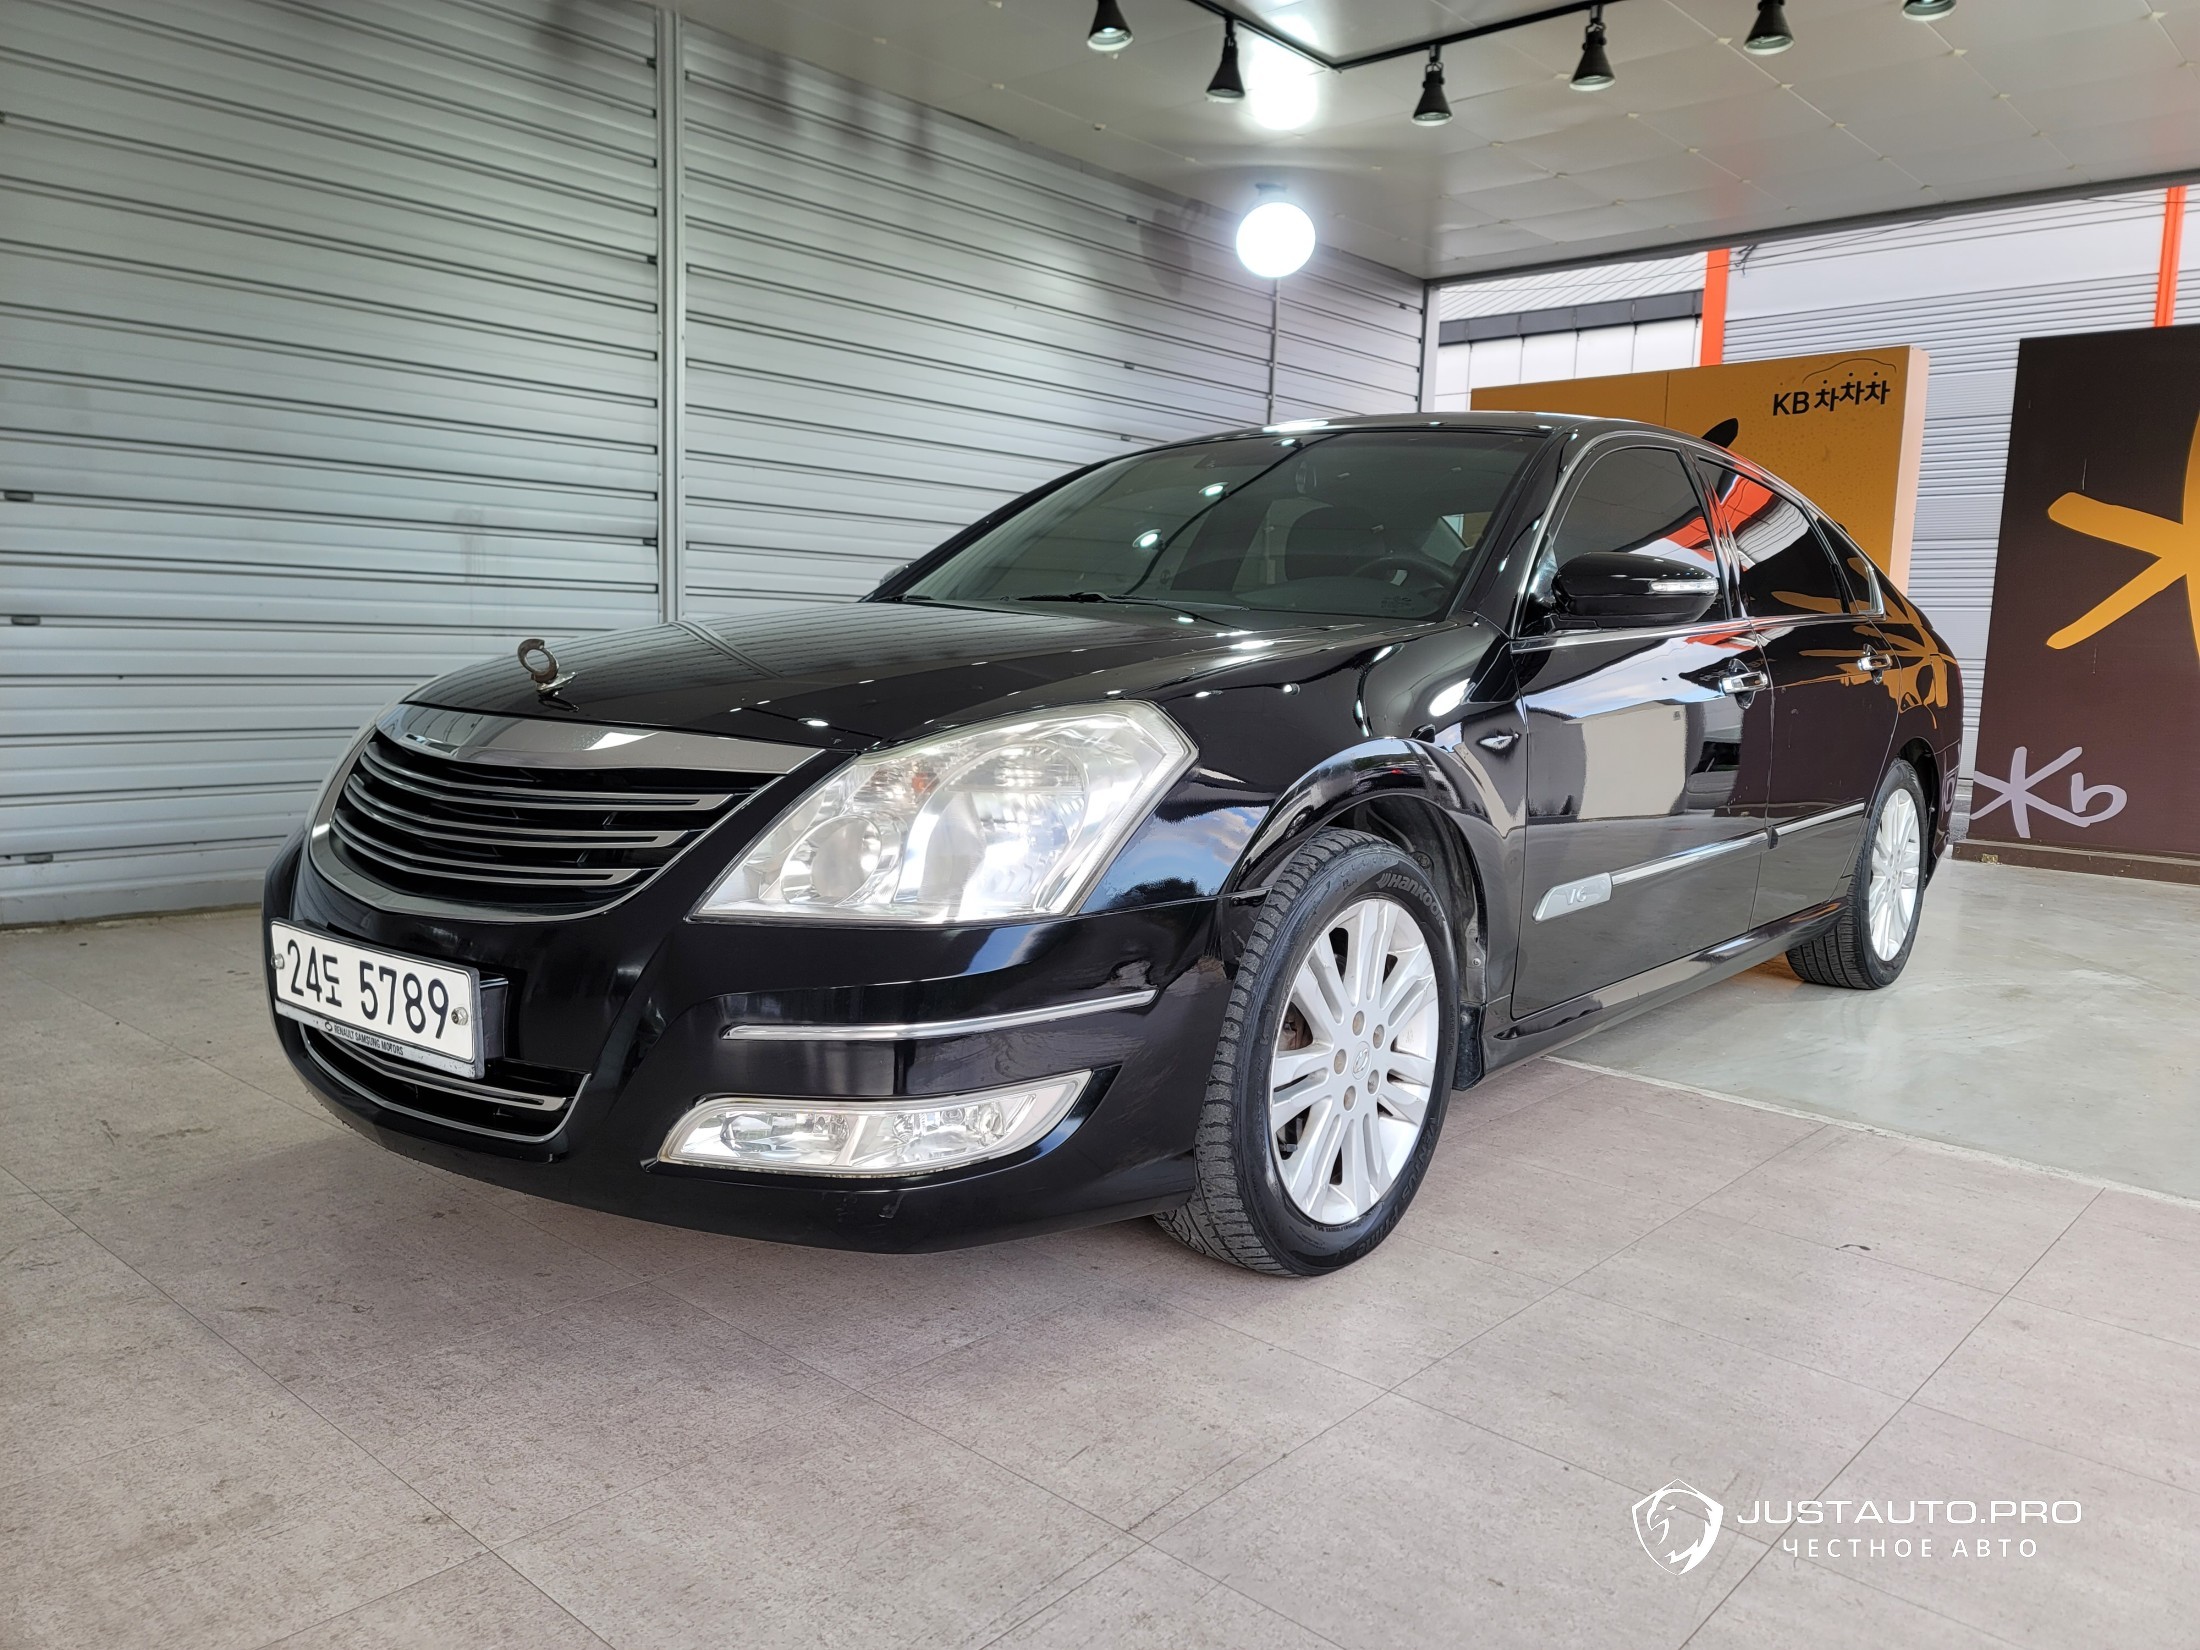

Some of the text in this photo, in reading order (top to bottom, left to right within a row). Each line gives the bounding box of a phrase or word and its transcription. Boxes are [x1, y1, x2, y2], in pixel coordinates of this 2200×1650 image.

[1772, 371, 1891, 417] KB 차차차
[1565, 886, 1587, 905] V6
[287, 939, 449, 1040] 24도 5789
[333, 1024, 404, 1056] RENAULT SAMSUNG MOTORS
